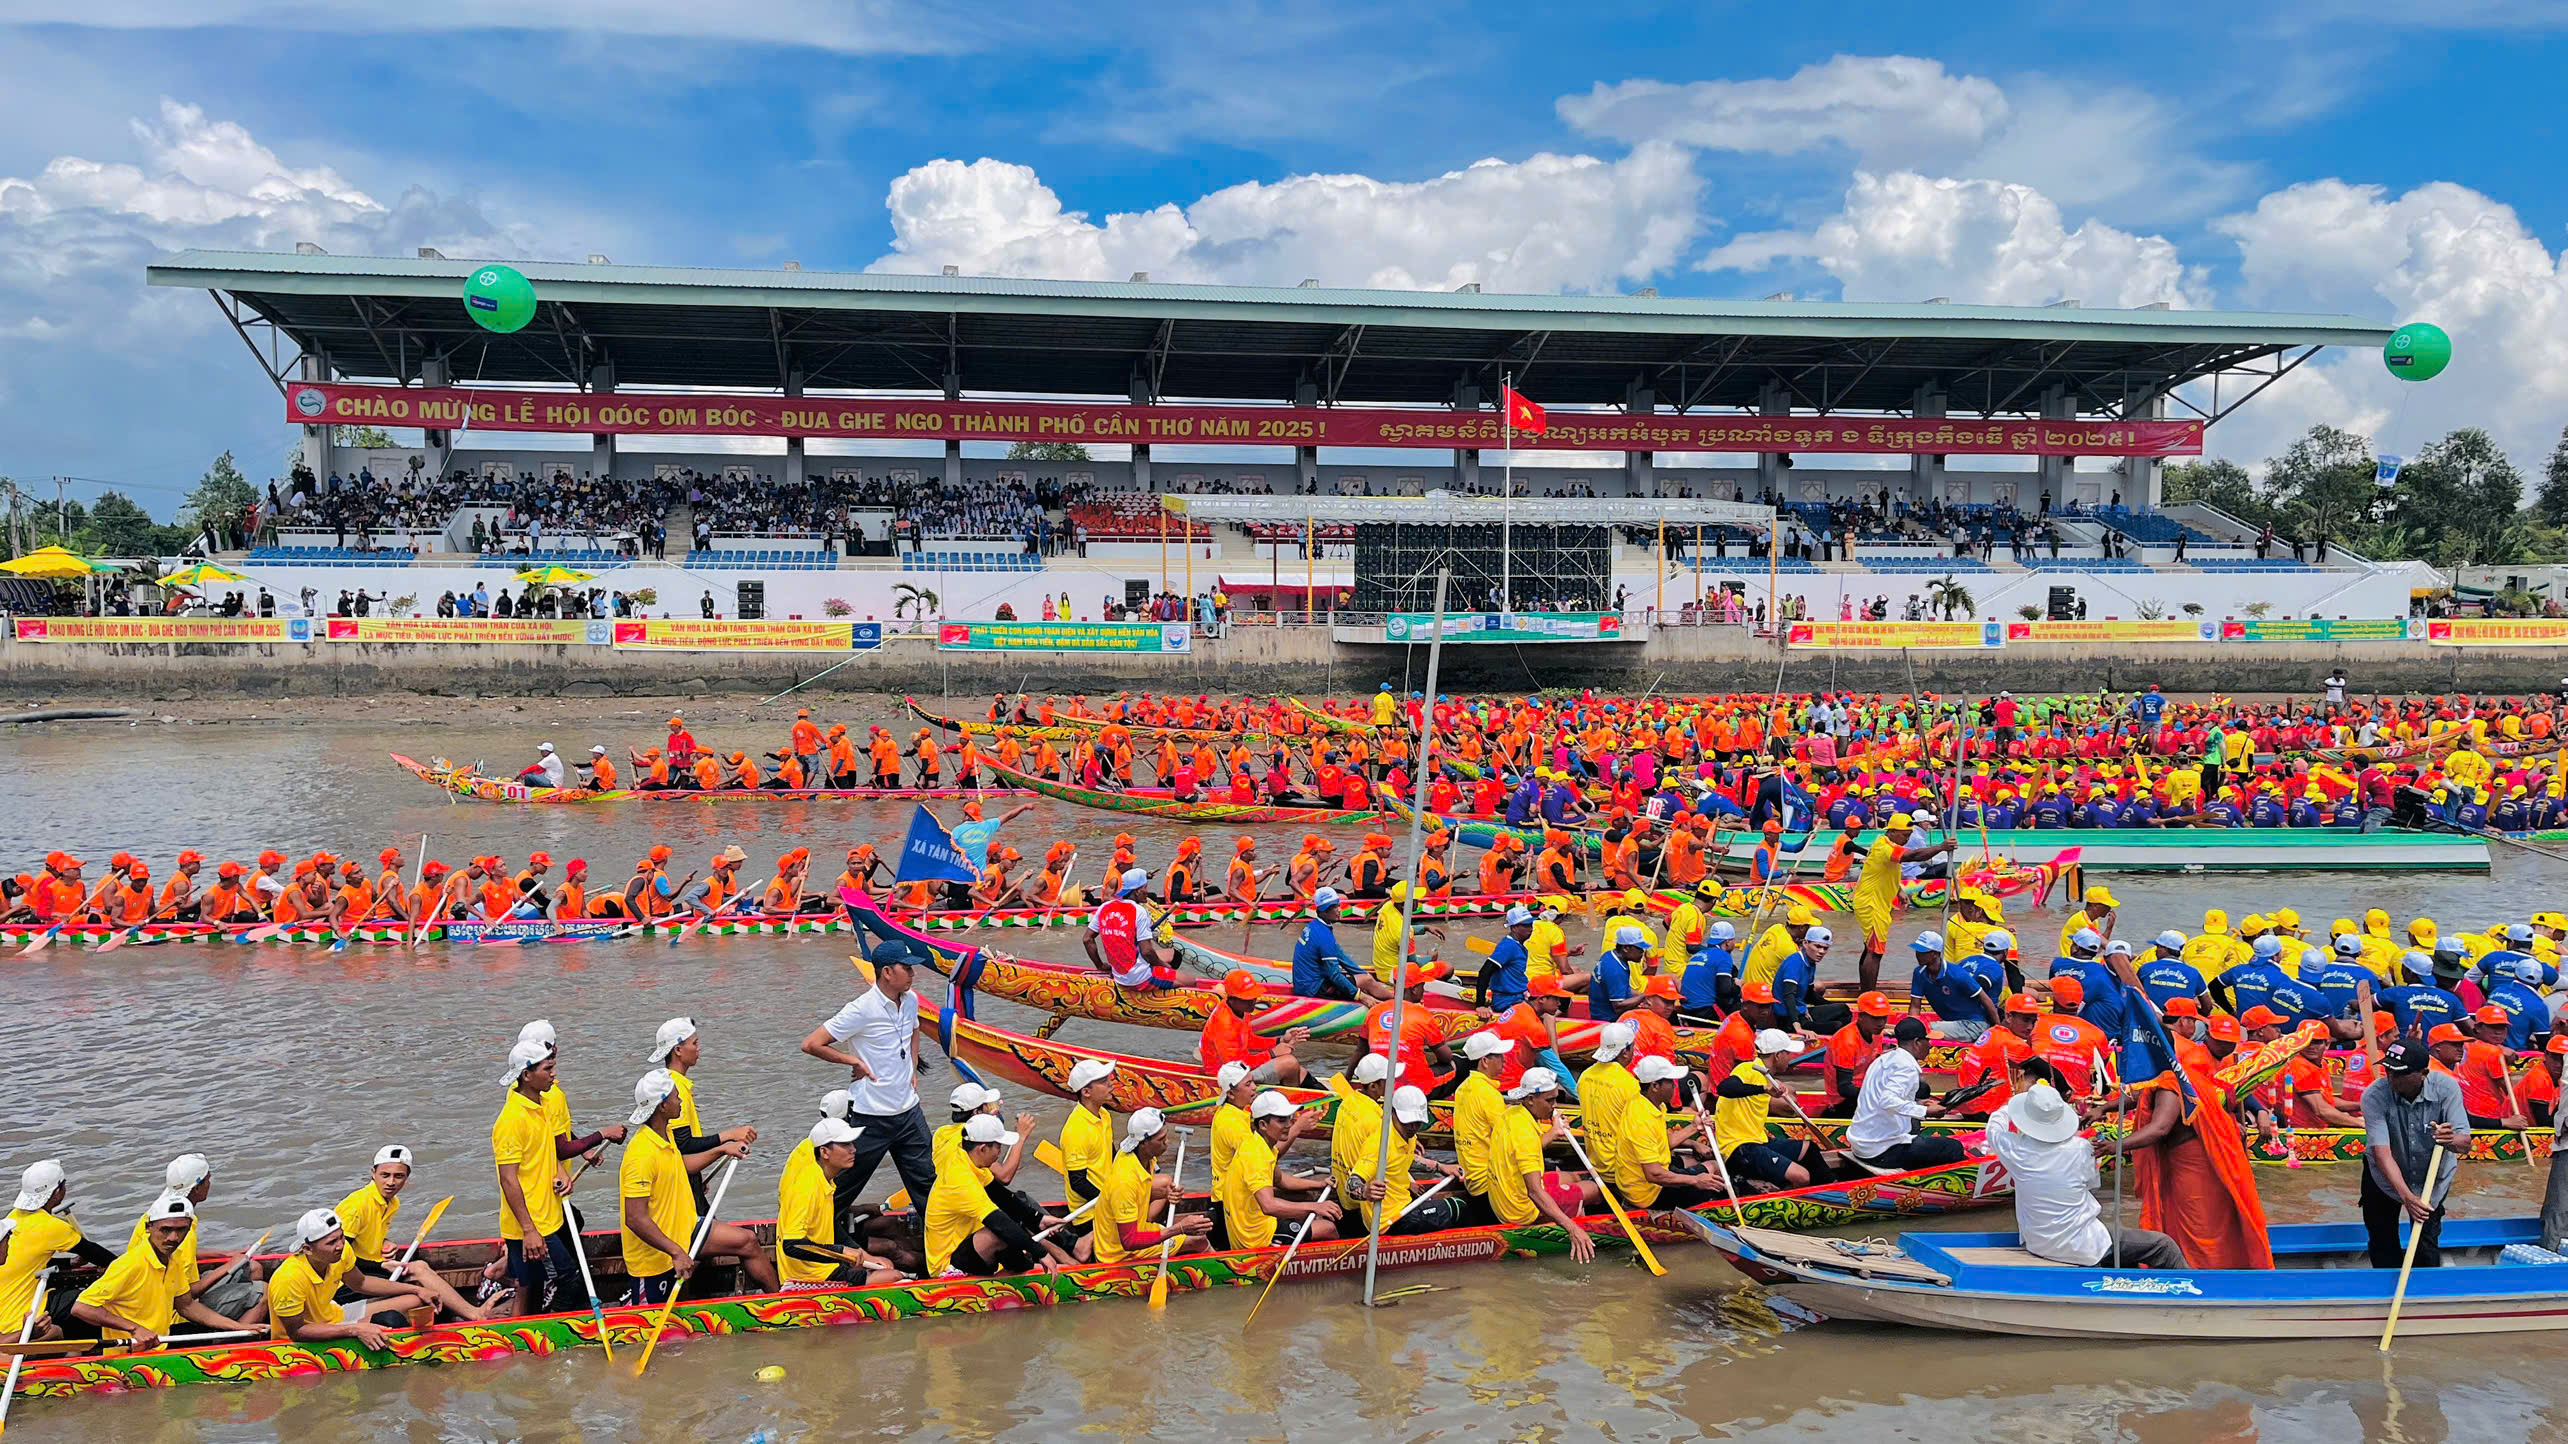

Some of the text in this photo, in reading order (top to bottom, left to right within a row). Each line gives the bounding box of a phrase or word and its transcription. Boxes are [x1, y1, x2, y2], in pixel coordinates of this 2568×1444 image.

[335, 393, 409, 418] CHÀO
[419, 399, 496, 421] MỪNG
[505, 397, 535, 422] LỄ
[546, 402, 590, 427] HỘI
[599, 402, 650, 425] OÓC
[659, 408, 697, 425] OM
[705, 405, 757, 427] BÓC
[781, 410, 831, 429] ĐUA
[838, 412, 886, 430] GHE
[896, 412, 943, 431] NGO
[950, 410, 1030, 433] THÀNH
[1038, 411, 1088, 434] PHỐ
[1094, 411, 1140, 436] CẦN
[1148, 416, 1195, 436] THƠ
[1200, 415, 1250, 437] NĂM
[1257, 419, 1314, 437] 2025
[2386, 747, 2400, 757] 27
[507, 786, 526, 799] 01
[1648, 800, 1661, 816] 18
[659, 1280, 668, 1295] 9
